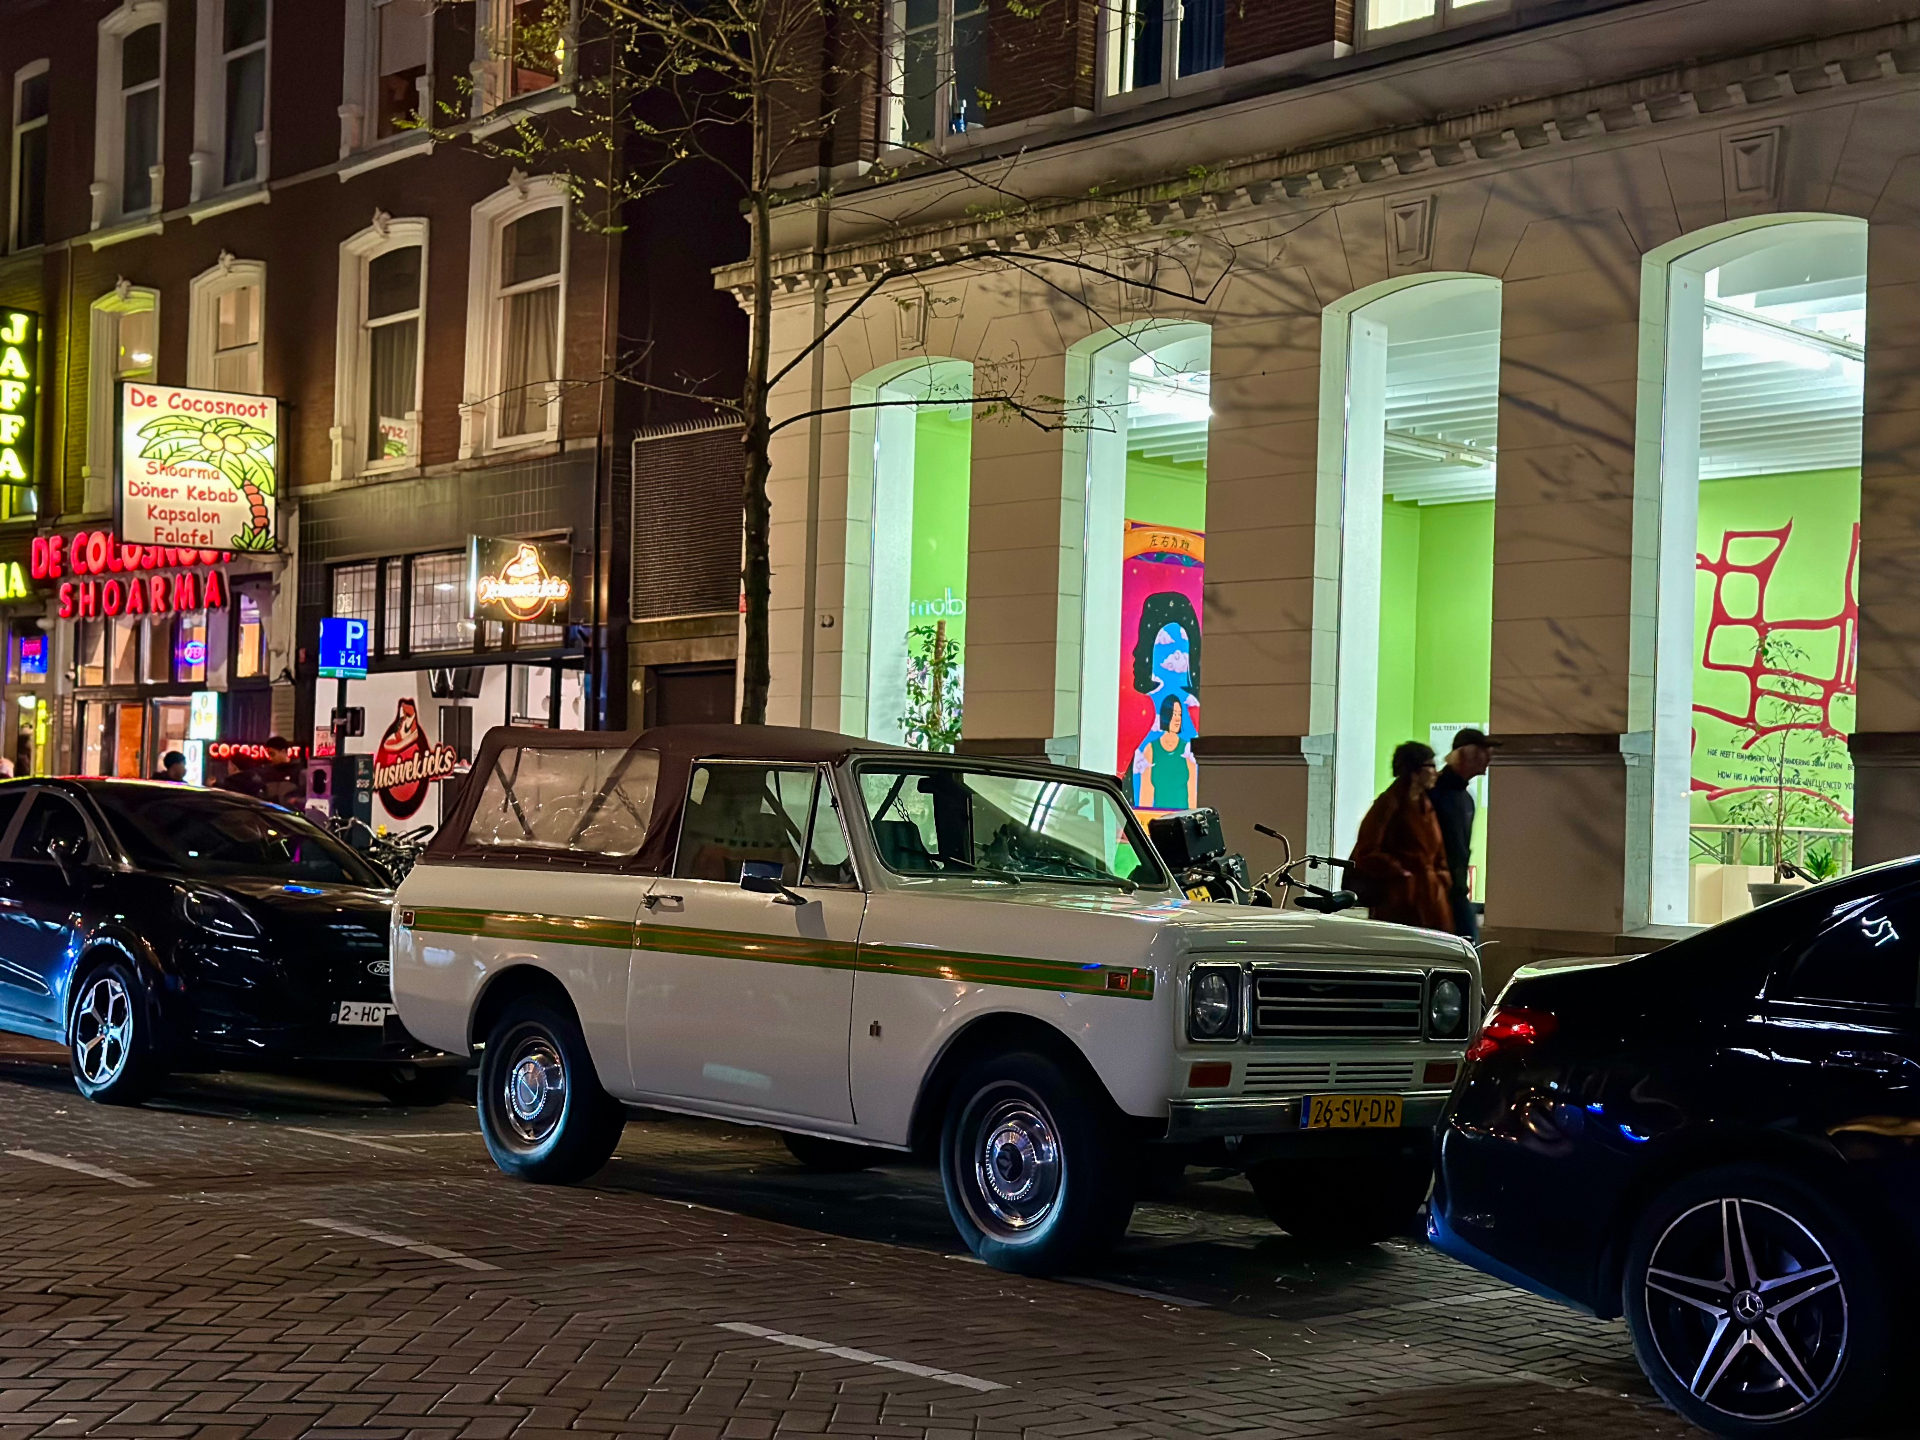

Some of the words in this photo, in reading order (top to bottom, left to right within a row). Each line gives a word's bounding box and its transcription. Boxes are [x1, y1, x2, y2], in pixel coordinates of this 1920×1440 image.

[1, 313, 30, 479] JAFFA
[131, 387, 158, 407] De
[168, 392, 268, 418] Cocosnoot
[146, 460, 221, 480] Shoarma
[128, 480, 179, 499] Döner
[187, 485, 239, 503] Kebab
[147, 504, 221, 525] Kapsalon
[154, 526, 214, 545] Falafel
[31, 535, 63, 579] DE
[59, 570, 221, 618] SHOARMA
[345, 620, 365, 649] P
[347, 653, 361, 667] 41
[1720, 750, 1735, 759] HEEFT
[1717, 770, 1733, 780] HOW
[1734, 772, 1743, 781] HAS
[1743, 774, 1748, 782] A
[1749, 774, 1773, 784] MOMENT
[1312, 1098, 1397, 1125] 26-SV-DR
